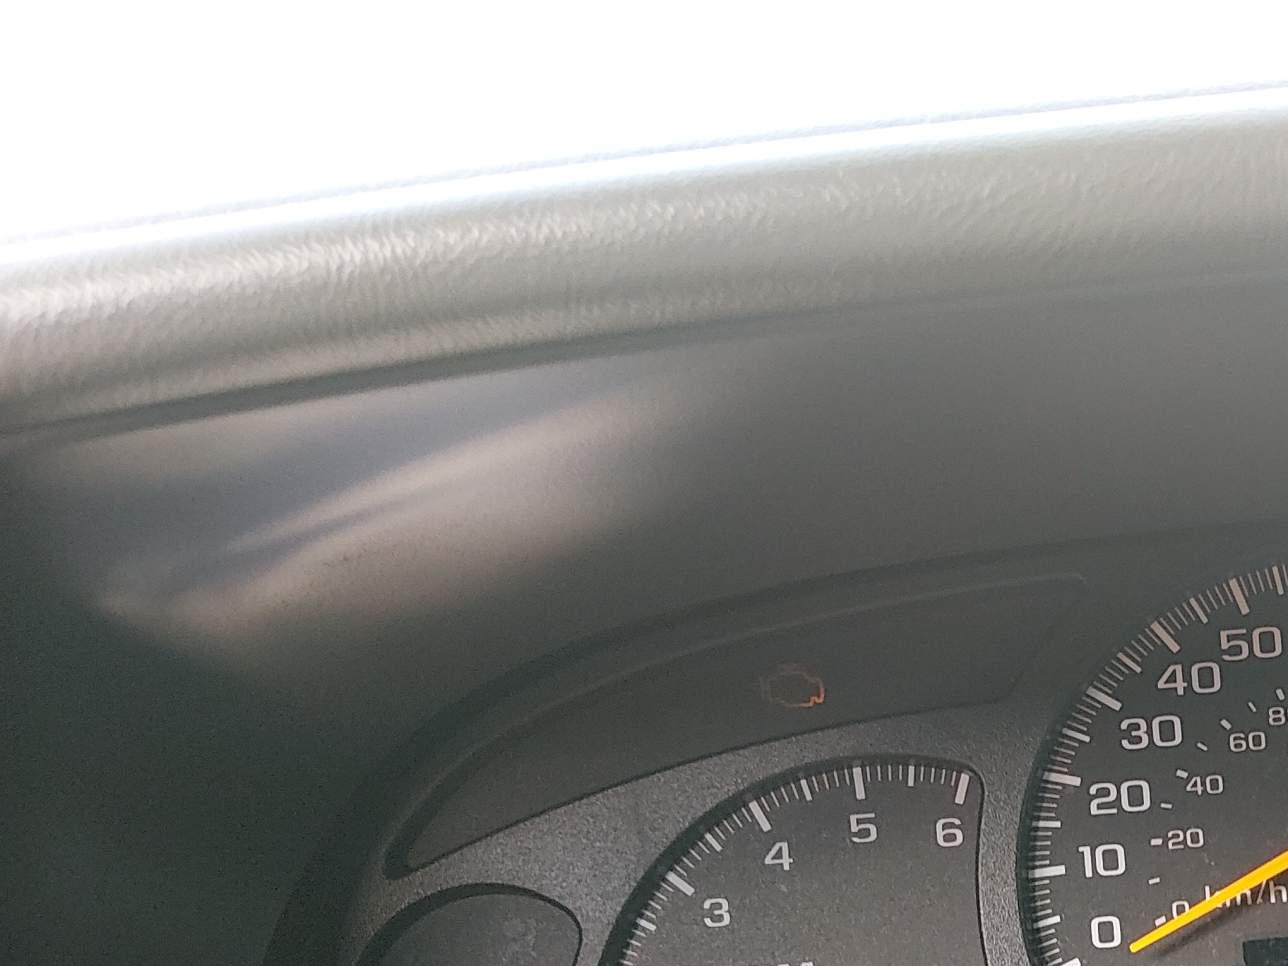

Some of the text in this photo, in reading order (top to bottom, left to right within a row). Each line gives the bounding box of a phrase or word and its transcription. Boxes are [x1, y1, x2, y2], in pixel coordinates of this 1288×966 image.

[1219, 626, 1282, 661] 50
[1157, 662, 1221, 696] 40
[1120, 715, 1182, 750] 30
[1229, 731, 1266, 752] 60
[1089, 780, 1151, 815] 20
[1185, 774, 1224, 796] 40
[849, 813, 878, 843] 5
[935, 817, 964, 847] 6
[1167, 828, 1204, 850] 20
[764, 841, 794, 871] 4
[1078, 843, 1126, 878] 10
[703, 898, 731, 928] 3
[1090, 915, 1122, 949] 0
